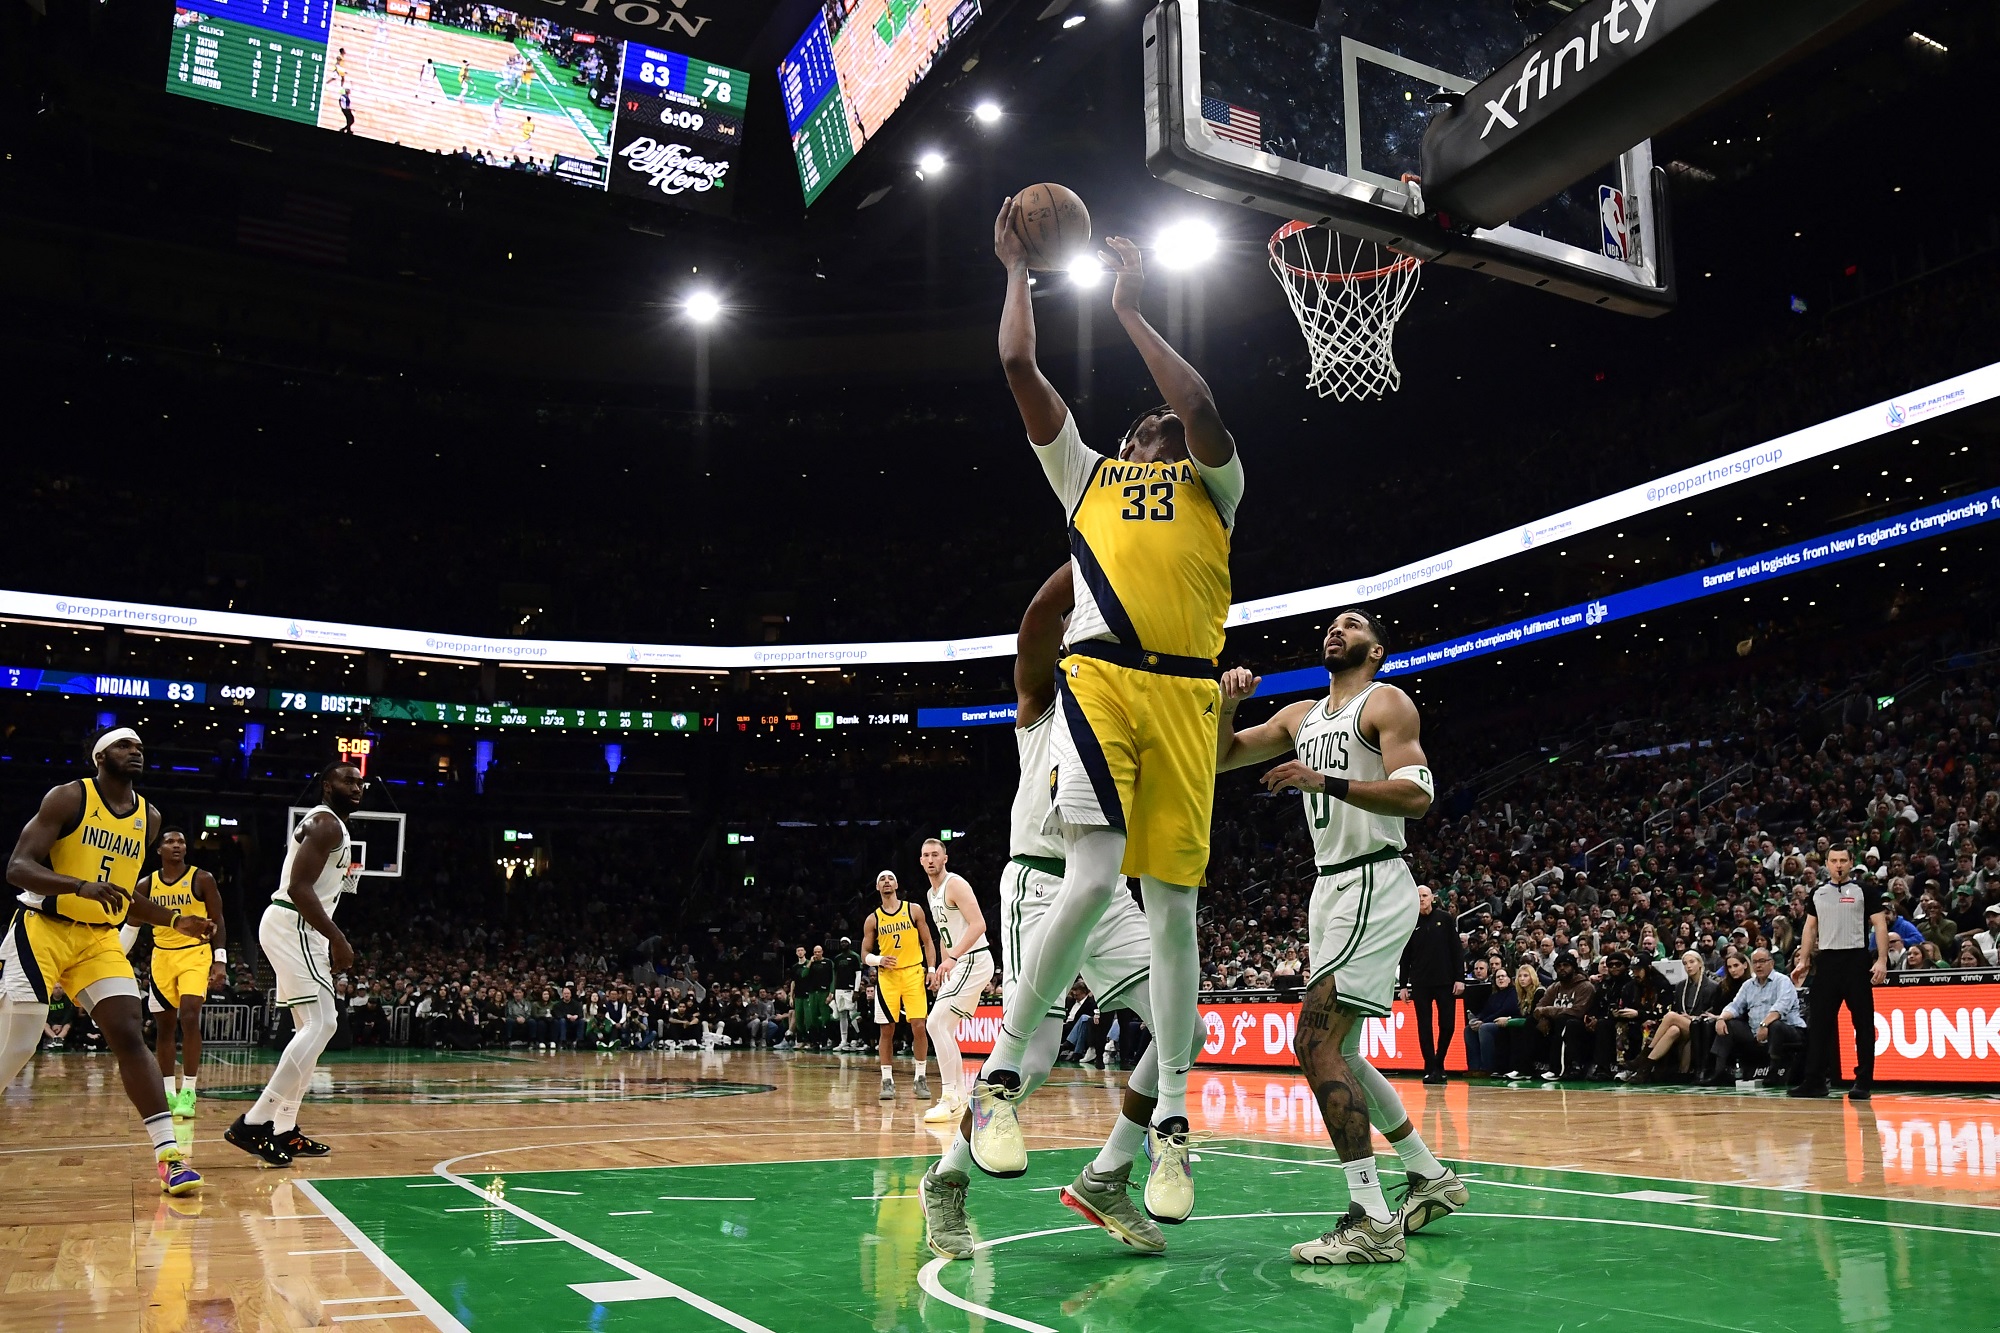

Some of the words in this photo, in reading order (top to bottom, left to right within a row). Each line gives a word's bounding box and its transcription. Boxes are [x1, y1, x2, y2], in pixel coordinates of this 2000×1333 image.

[198, 25, 224, 36] CELTICS
[184, 43, 189, 52] 7
[195, 46, 219, 59] BROWN
[196, 36, 218, 49] TATUM
[276, 55, 282, 64] 5
[296, 60, 302, 69] 5
[193, 65, 219, 79] HAUSER
[194, 55, 215, 68] WHITE
[294, 79, 299, 88] 2
[639, 62, 670, 87] 83
[1480, 0, 1657, 140] xfinity
[192, 75, 222, 89] HORFORD
[252, 88, 257, 97] 2
[701, 78, 731, 103] 78
[627, 102, 639, 111] 17
[660, 108, 704, 131] 6:09
[718, 124, 735, 136] 3rd
[619, 136, 730, 178] Different
[648, 166, 714, 195] Here
[1607, 243, 1620, 257] NBA
[1909, 402, 1926, 412] PREP
[1928, 389, 1965, 405] PARTNERS
[1647, 447, 1783, 502] @preppartnersgroup
[1121, 481, 1175, 521] 33
[1703, 571, 1736, 588] Banner
[1737, 562, 1760, 579] level
[1761, 552, 1800, 573] logistics
[1802, 545, 1829, 561] from
[1830, 537, 1856, 554] New
[1857, 522, 1907, 546] England's
[1910, 500, 1988, 532] championship
[1356, 558, 1453, 596] @preppartnersgroup
[55, 601, 198, 627] @preppartnersgroup
[426, 637, 548, 656] @preppartnersgroup
[1380, 658, 1409, 673] ogistics
[1410, 655, 1426, 667] from
[1427, 651, 1443, 662] New
[1444, 640, 1474, 658] England's
[1475, 628, 1522, 649] championship
[1523, 617, 1560, 636] fulfillment
[1561, 612, 1582, 626] team
[753, 649, 867, 662] @preppartnersgroup
[11, 677, 18, 686] 2
[95, 677, 150, 697] INDIANA
[167, 682, 194, 700] 83
[220, 685, 255, 699] 6:09
[281, 692, 307, 709] 78
[438, 711, 445, 720] 2
[457, 713, 465, 721] 4
[475, 714, 492, 723] 54.5
[501, 715, 527, 725] 30/55
[540, 716, 565, 725] 12/32
[578, 718, 585, 726] 5
[600, 718, 607, 727] 6
[620, 719, 631, 727] 20
[643, 719, 653, 728] 21
[703, 717, 714, 726] 17
[761, 716, 779, 724] 6:08
[817, 714, 832, 726] TD
[836, 715, 859, 724] Bank
[868, 713, 889, 725] 7:34
[892, 714, 908, 724] PM
[962, 711, 988, 721] Banner
[989, 709, 1006, 719] level
[338, 738, 370, 754] 6:08
[1299, 731, 1349, 770] CELTICS
[82, 825, 141, 860] INDIANA
[97, 855, 114, 883] 5
[150, 893, 192, 907] INDIANA
[879, 921, 911, 935] INDIANA
[893, 934, 901, 948] 2
[1960, 974, 1983, 982] xfinity
